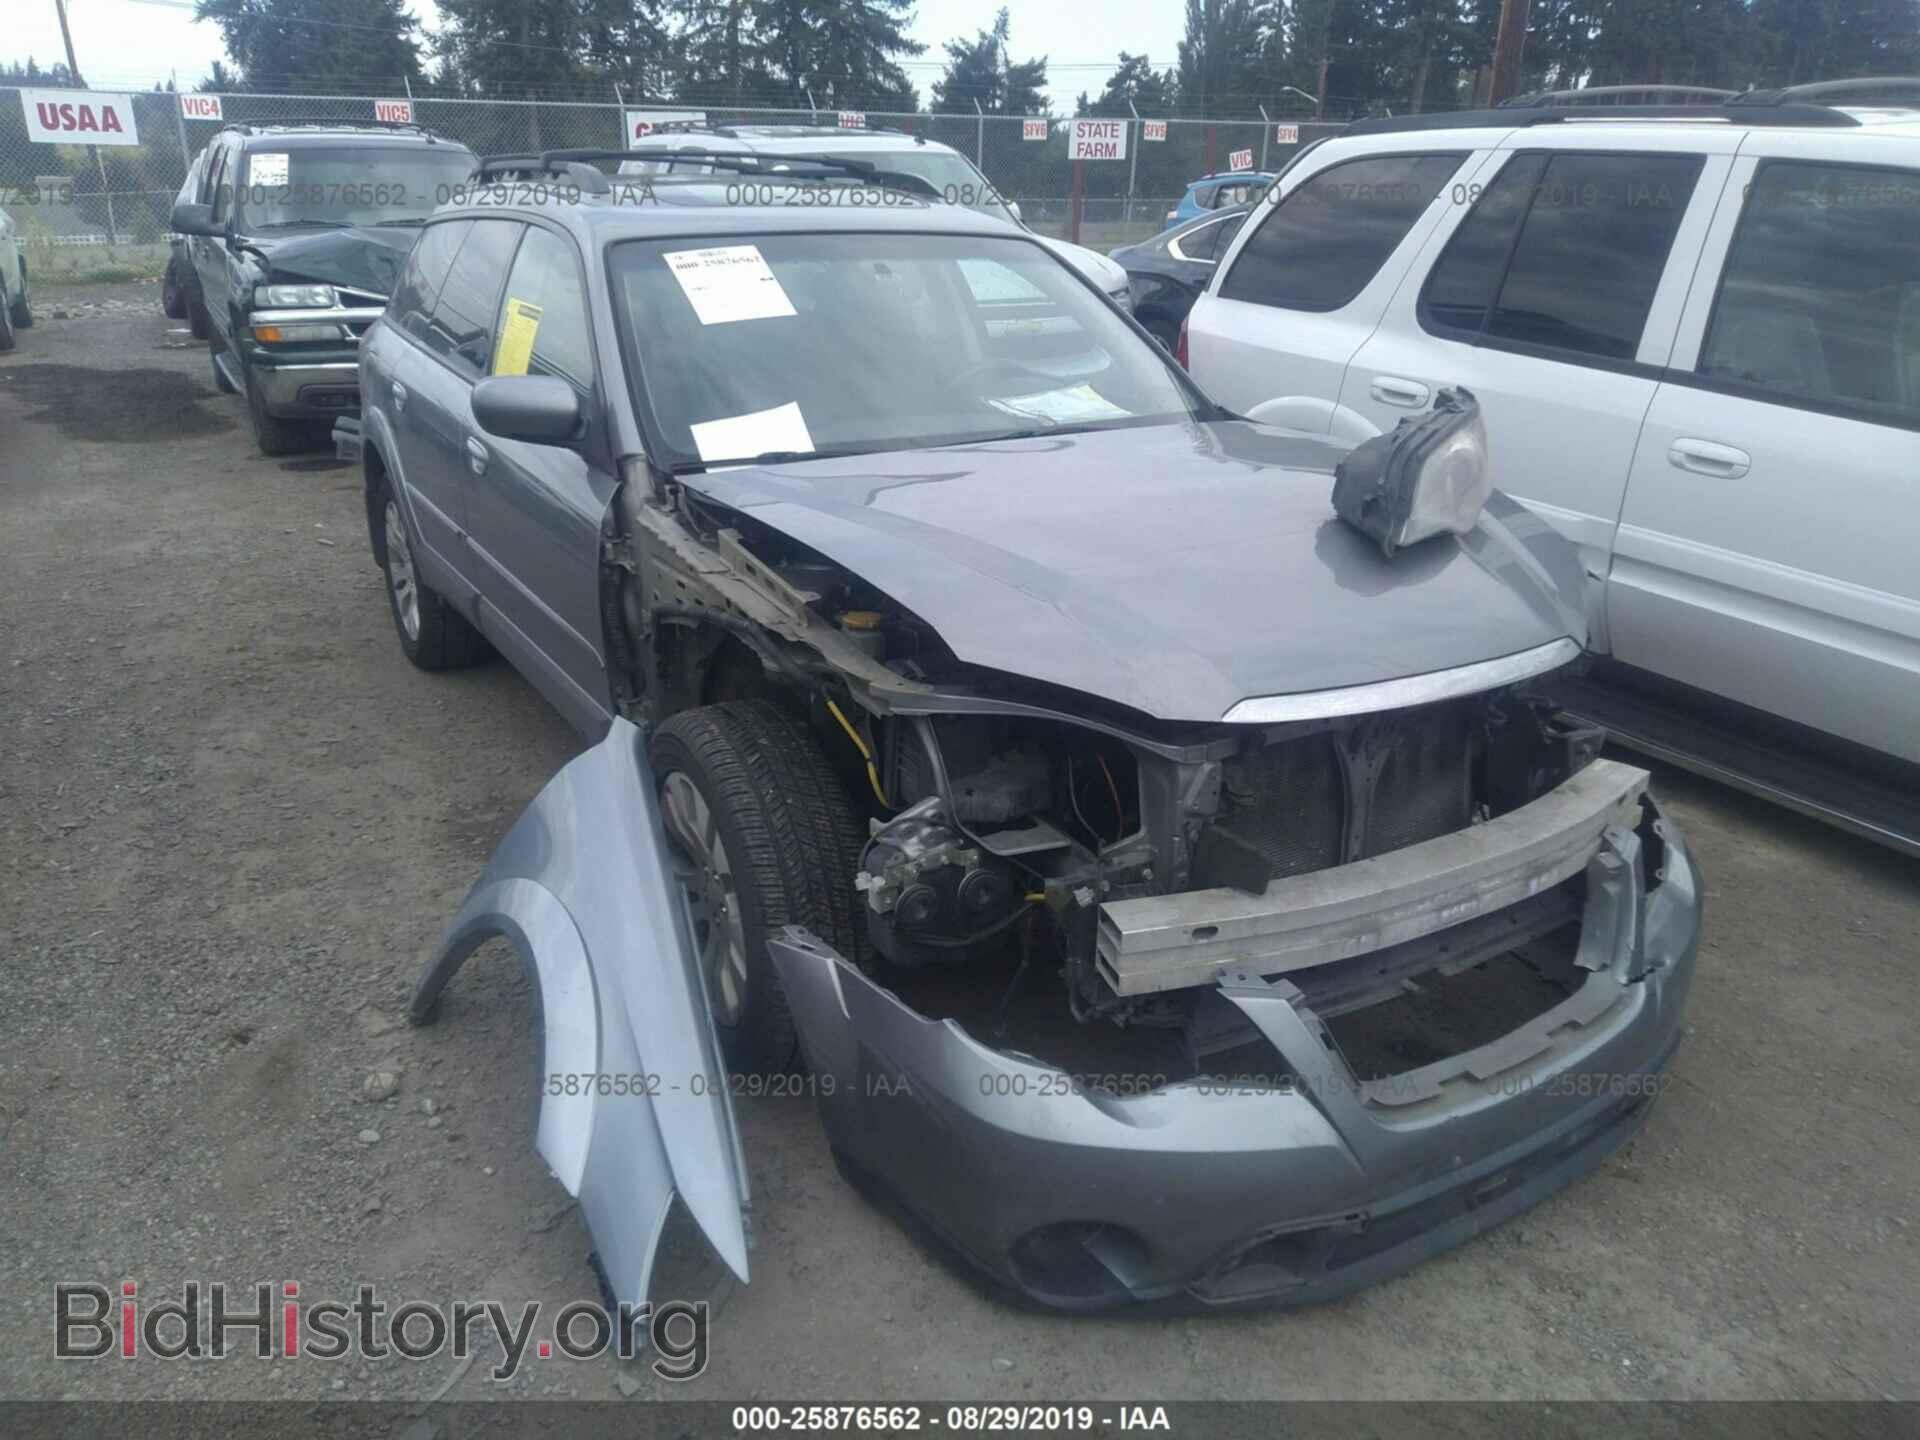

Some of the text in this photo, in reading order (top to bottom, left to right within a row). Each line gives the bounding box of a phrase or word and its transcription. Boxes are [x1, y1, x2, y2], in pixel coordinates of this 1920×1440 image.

[183, 98, 219, 116] VIC4
[377, 104, 410, 121] VIC5
[36, 102, 123, 133] USAA
[1076, 122, 1119, 138] STATE
[1077, 142, 1117, 158] FARM
